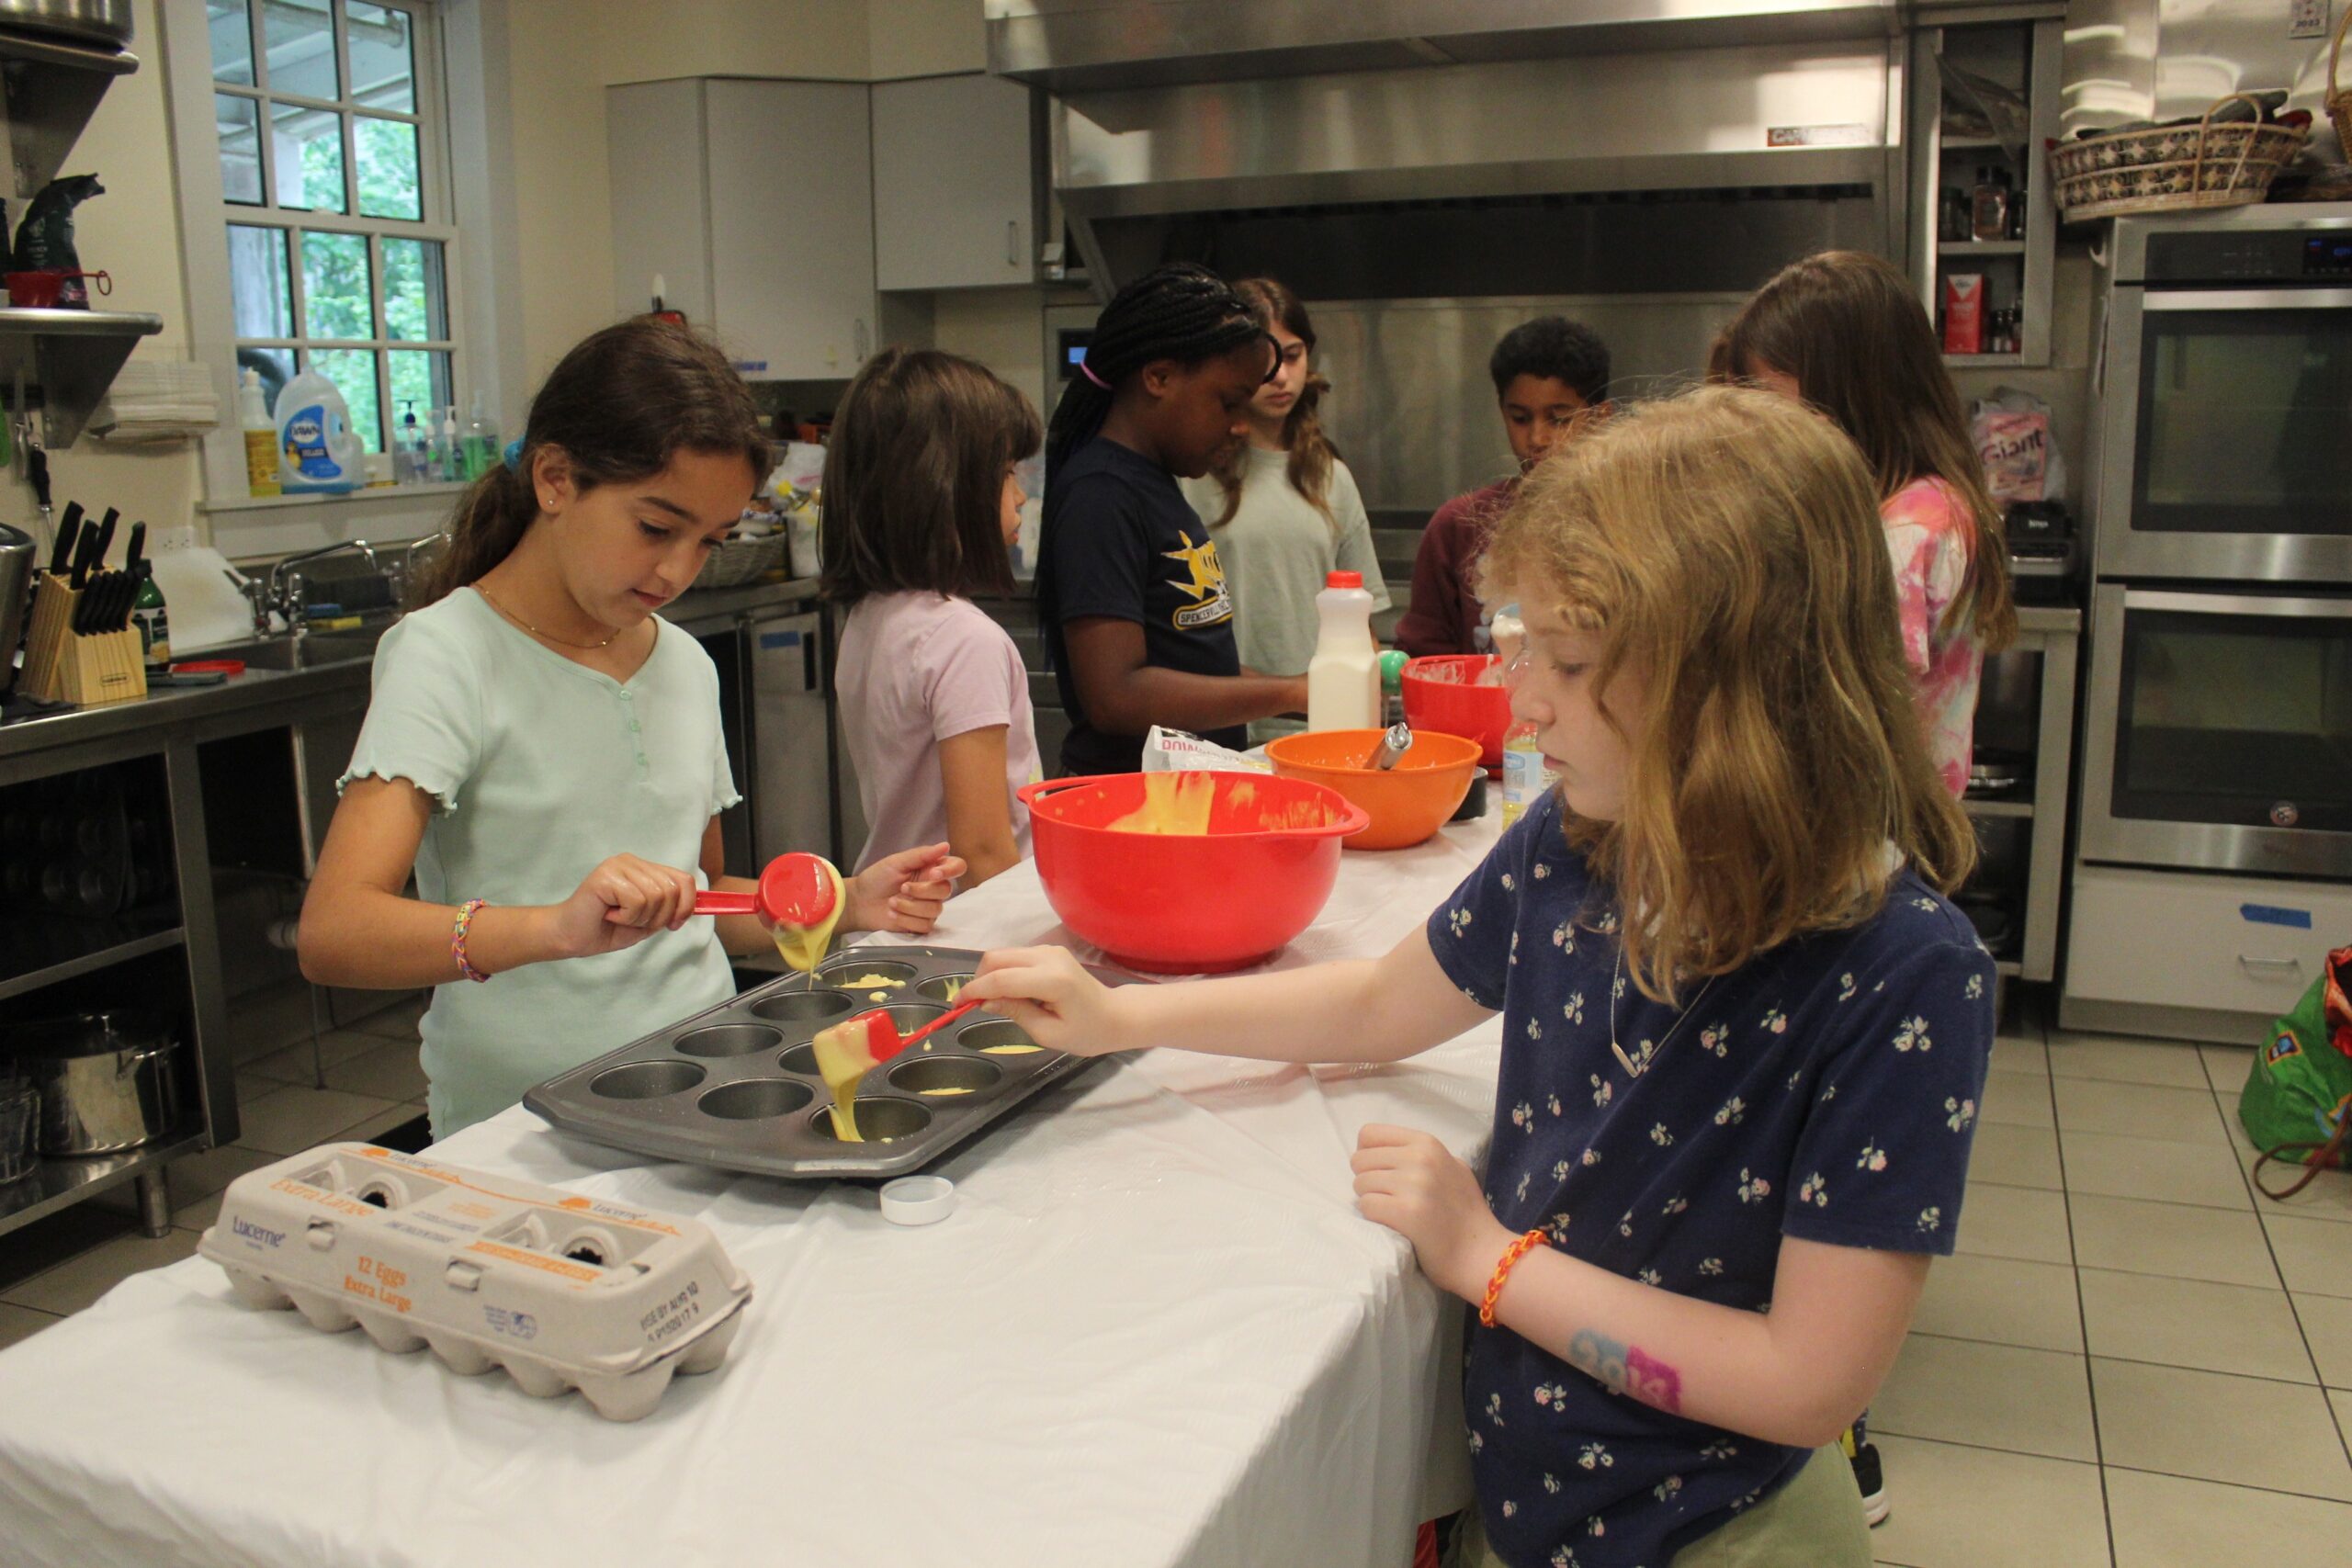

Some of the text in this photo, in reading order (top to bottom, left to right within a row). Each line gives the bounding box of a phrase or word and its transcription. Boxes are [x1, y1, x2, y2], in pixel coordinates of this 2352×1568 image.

[290, 425, 320, 435] DAWN
[270, 1177, 376, 1217] Extra Large
[232, 1215, 286, 1248] Lucerne
[358, 1256, 407, 1287] 12 Eggs
[344, 1274, 412, 1313] Extra Large
